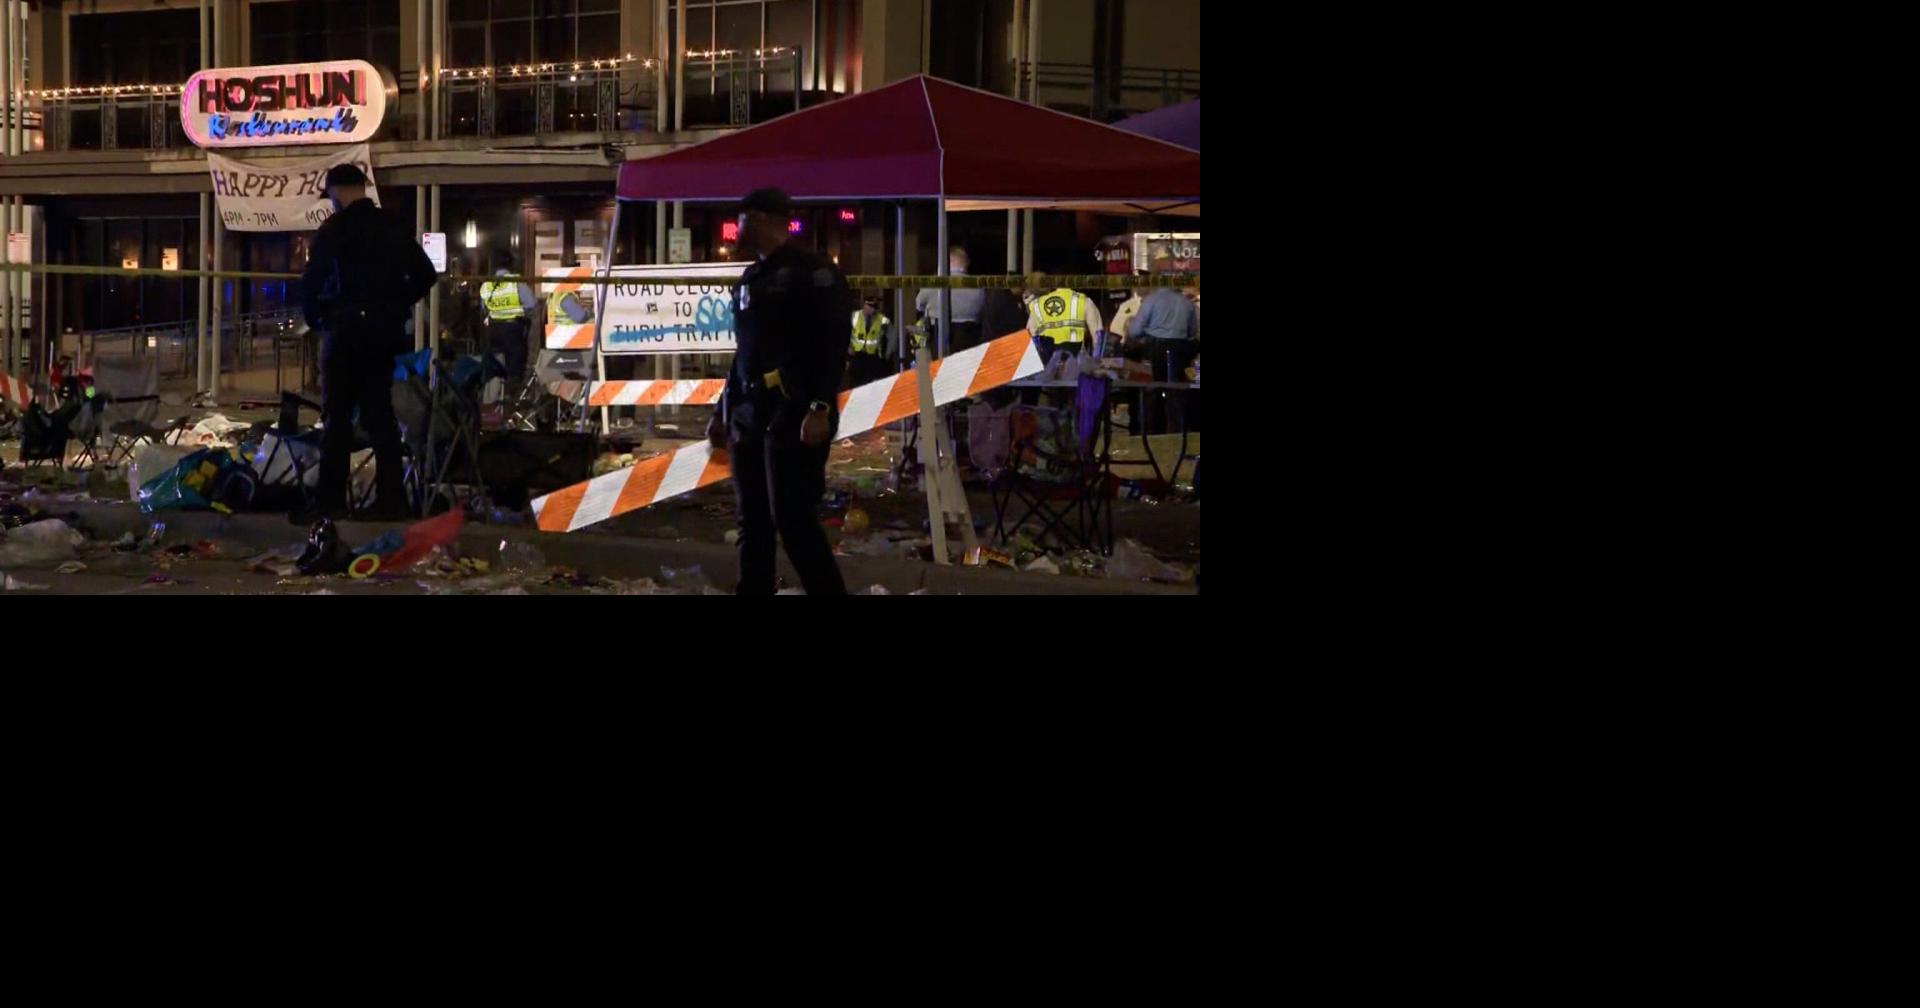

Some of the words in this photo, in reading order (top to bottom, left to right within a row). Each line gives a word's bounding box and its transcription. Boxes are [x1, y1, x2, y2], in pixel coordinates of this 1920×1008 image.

[199, 70, 366, 113] HOSHUN
[213, 168, 289, 197] HAPPY
[223, 210, 243, 225] 4PM
[256, 212, 279, 226] 7PM
[614, 282, 664, 297] ROAD
[674, 301, 692, 318] TO
